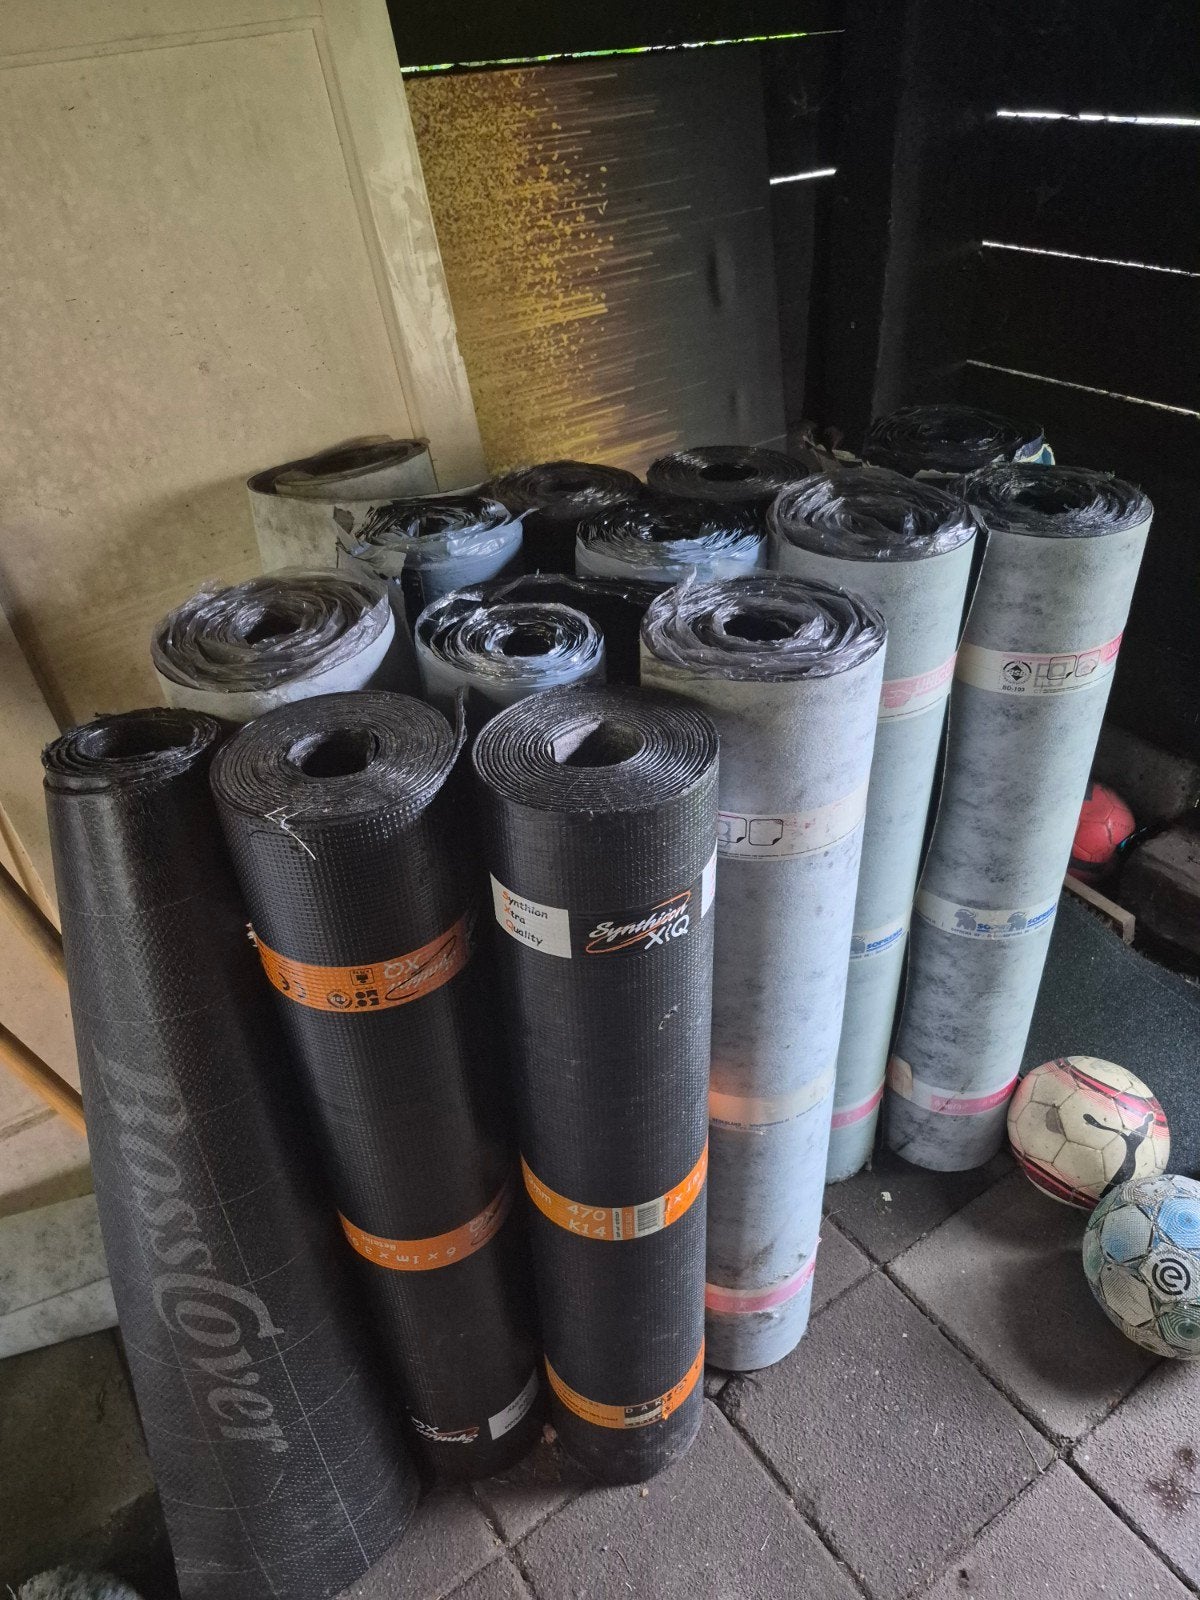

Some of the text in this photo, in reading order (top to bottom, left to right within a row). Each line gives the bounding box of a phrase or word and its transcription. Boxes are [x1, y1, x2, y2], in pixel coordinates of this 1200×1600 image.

[502, 890, 549, 920] Synthion
[502, 906, 526, 925] Xtra
[505, 919, 544, 947] Quality
[589, 901, 688, 943] Synthion
[568, 1204, 607, 1222] 470
[568, 1219, 607, 1237] K14
